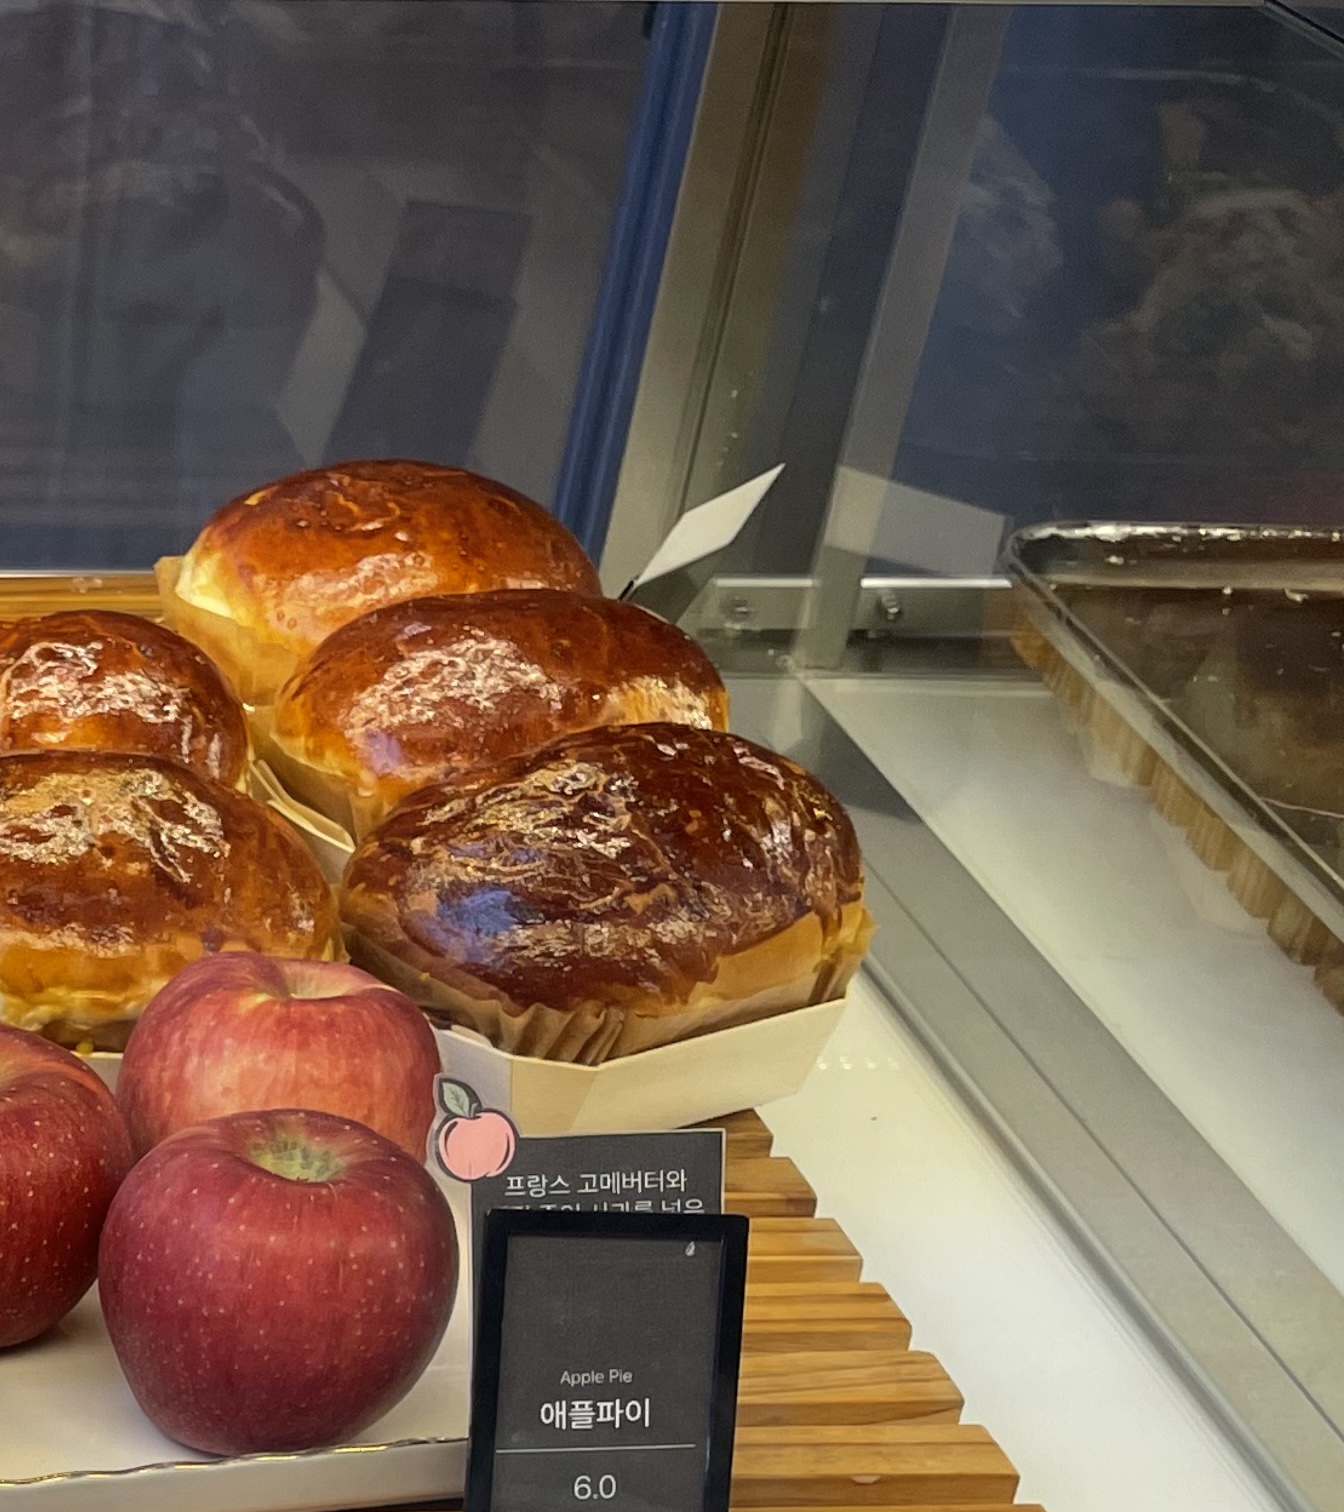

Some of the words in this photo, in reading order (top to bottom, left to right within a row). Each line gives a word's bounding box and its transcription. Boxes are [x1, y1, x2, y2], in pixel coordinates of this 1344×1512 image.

[504, 1173, 572, 1199] 프랑스
[576, 1168, 689, 1196] 고메버터와
[559, 1369, 605, 1388] Apple
[608, 1368, 633, 1385] Pie
[539, 1396, 651, 1431] 애플파이
[573, 1474, 617, 1501] 6.0
